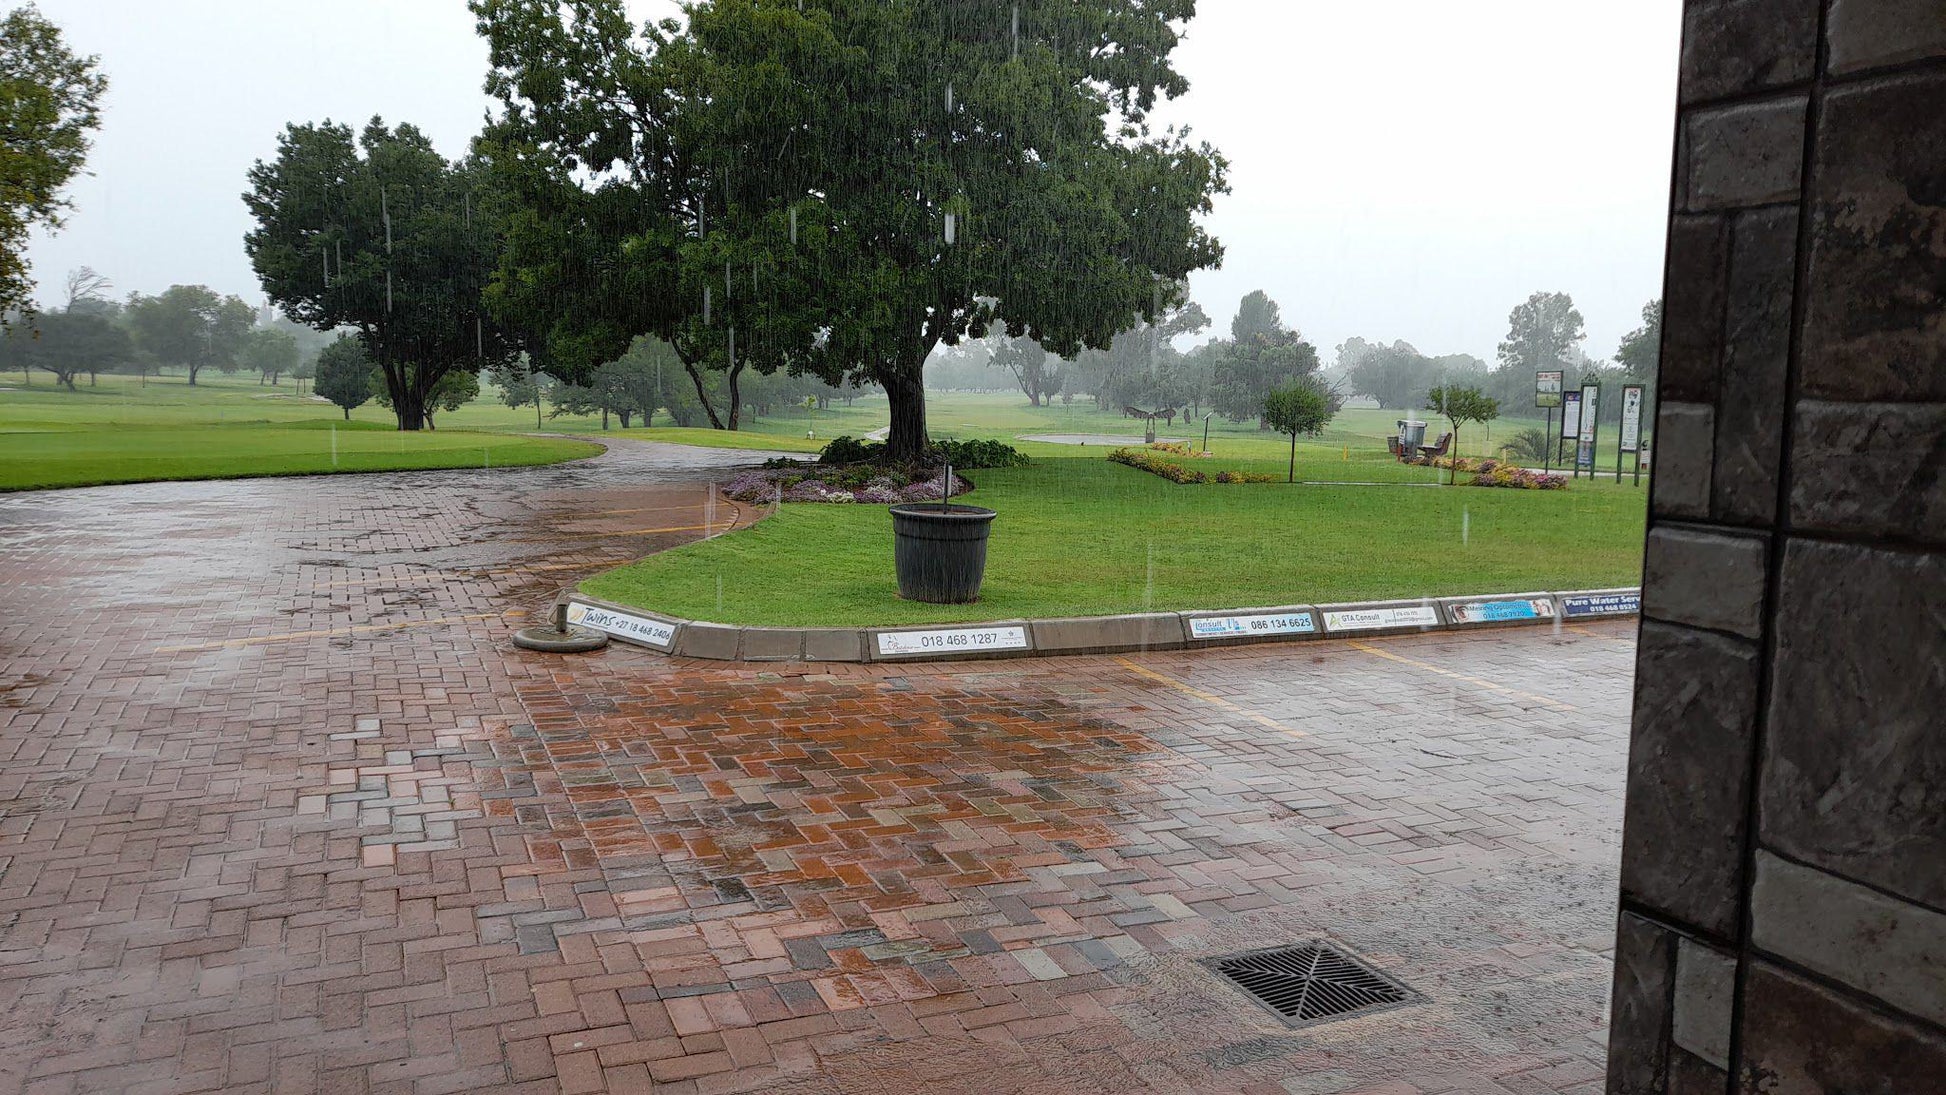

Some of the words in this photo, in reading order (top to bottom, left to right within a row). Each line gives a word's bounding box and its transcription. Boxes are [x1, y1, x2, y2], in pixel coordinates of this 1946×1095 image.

[1590, 597, 1619, 605] Water
[581, 607, 616, 626] Twins
[615, 620, 628, 629] +27
[629, 622, 637, 632] 18
[638, 625, 651, 635] 468
[652, 628, 671, 640] 2406
[1251, 620, 1268, 630] 086
[1271, 619, 1287, 629] 134
[1289, 617, 1311, 628] 6625
[1341, 614, 1355, 622] GTA
[1355, 613, 1380, 622] Consult
[921, 635, 943, 648] 018
[946, 634, 968, 646] 468
[971, 633, 997, 645] 1287
